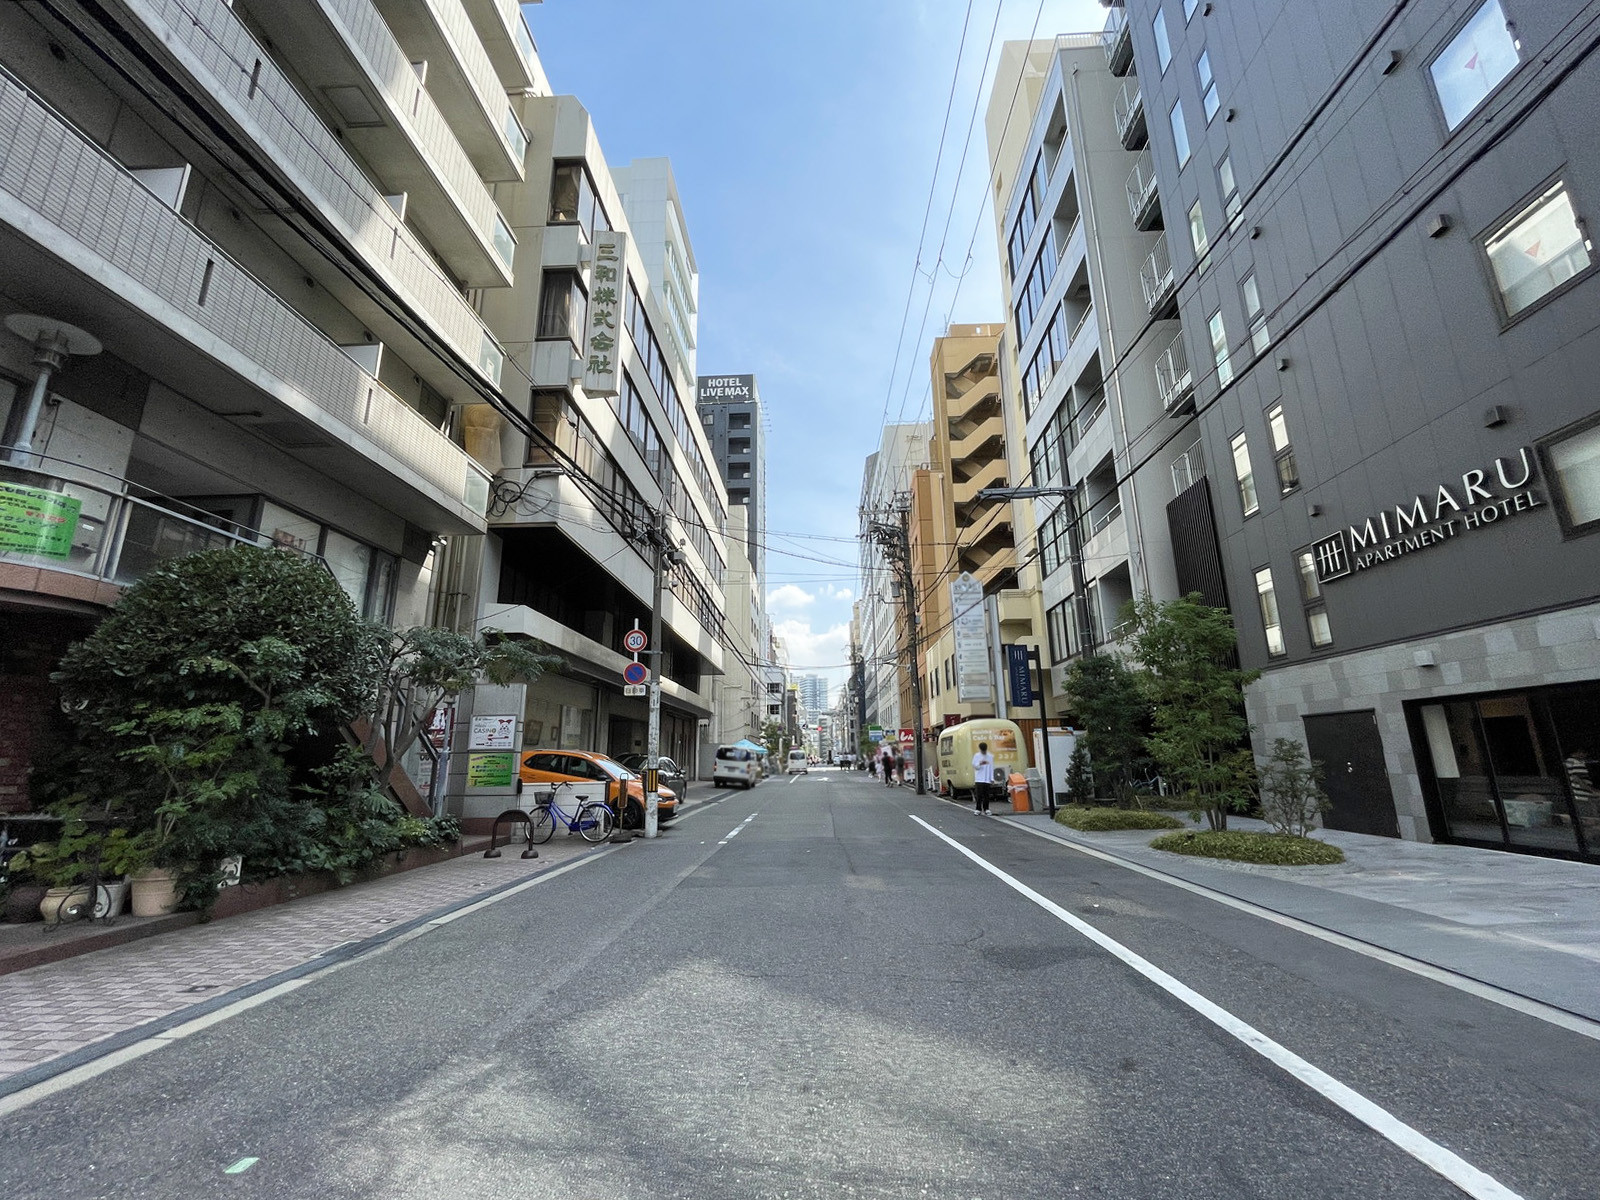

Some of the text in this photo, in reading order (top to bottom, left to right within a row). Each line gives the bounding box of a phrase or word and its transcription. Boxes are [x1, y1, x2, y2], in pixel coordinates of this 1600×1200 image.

[586, 243, 618, 375] 三和株式会社
[708, 378, 742, 387] HOTEL
[1349, 447, 1531, 553] MIMARU
[1355, 491, 1541, 571] APARTMENT HOTEL
[629, 636, 643, 646] 30
